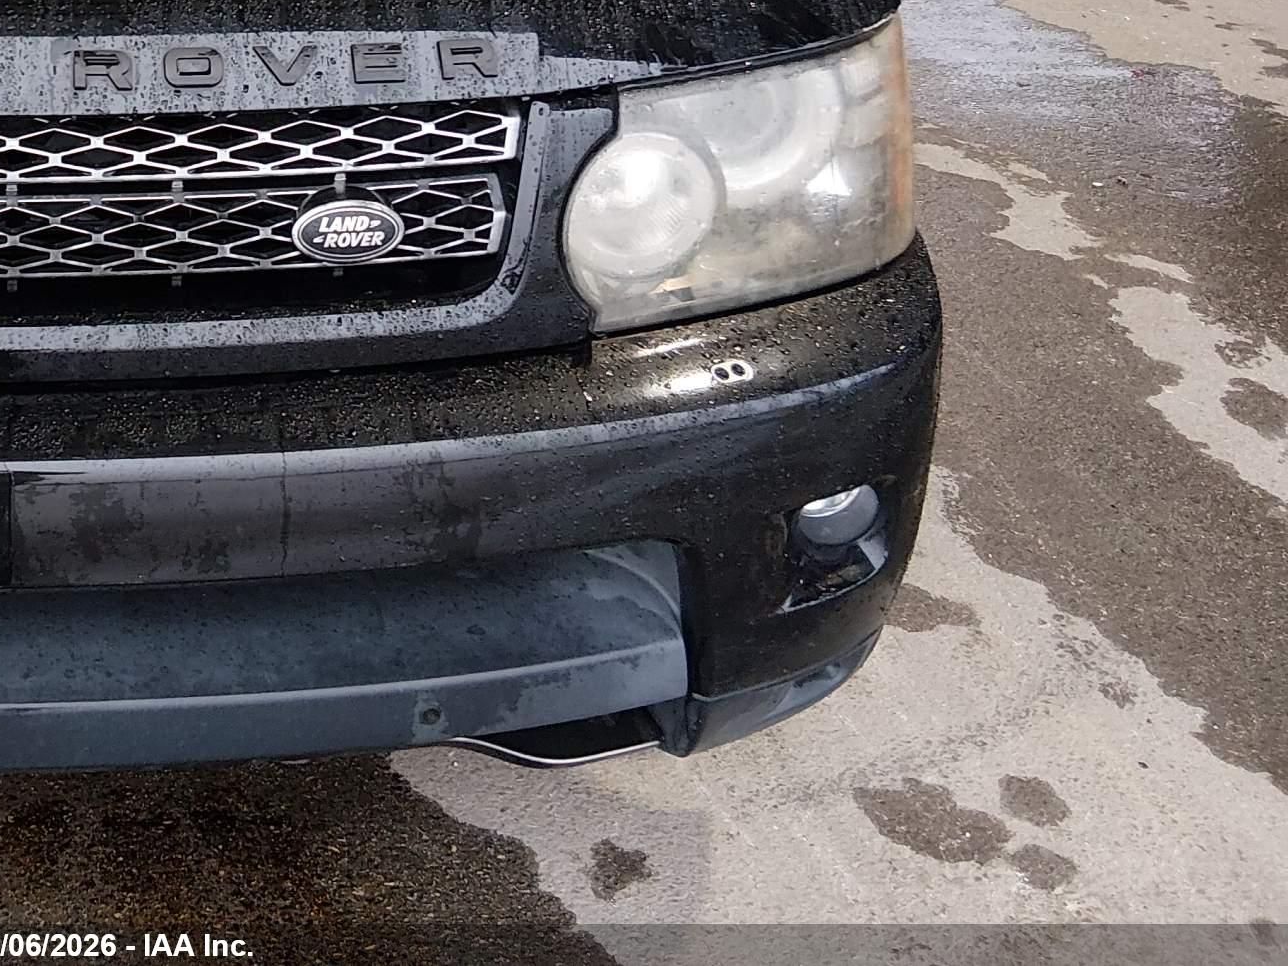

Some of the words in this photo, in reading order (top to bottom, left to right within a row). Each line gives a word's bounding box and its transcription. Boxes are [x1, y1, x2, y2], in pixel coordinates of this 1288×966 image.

[71, 37, 499, 91] ROVER
[319, 215, 370, 233] LAND
[323, 231, 385, 248] ROVER
